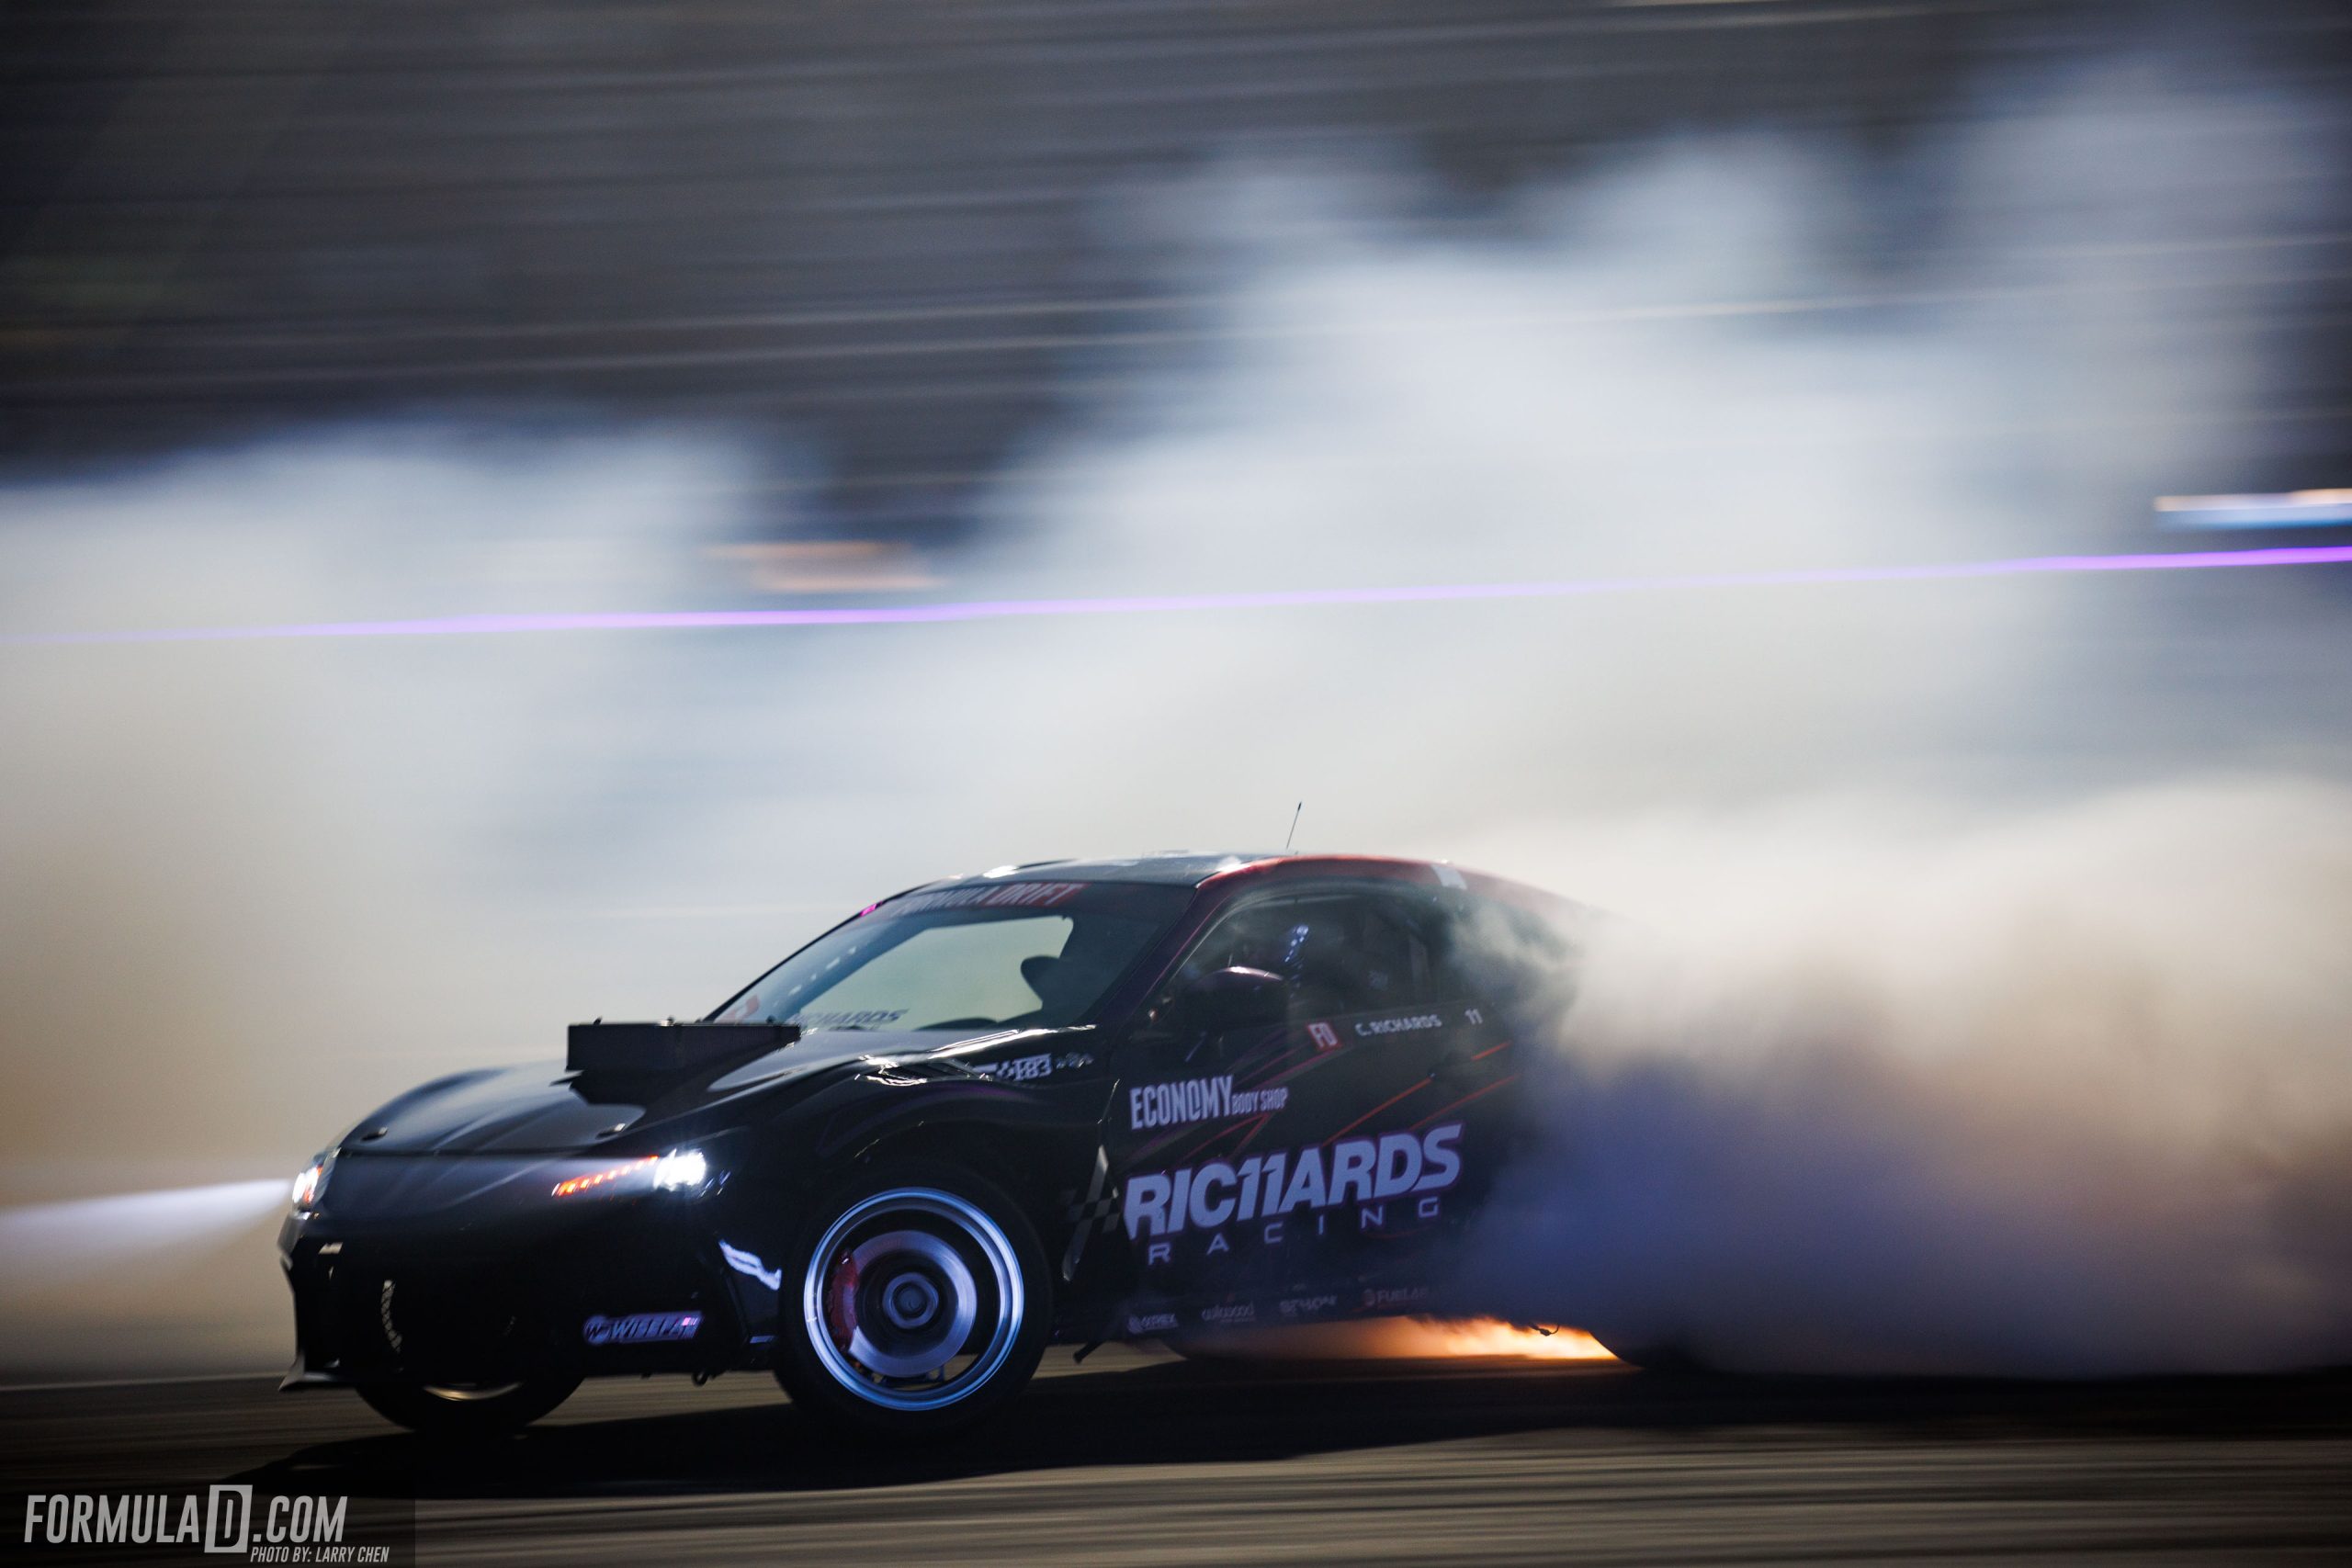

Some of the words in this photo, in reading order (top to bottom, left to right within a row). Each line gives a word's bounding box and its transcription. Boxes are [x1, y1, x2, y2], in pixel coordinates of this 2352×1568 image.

[1464, 1009, 1484, 1025] 11
[1129, 1075, 1234, 1130] ECONOMY
[1231, 1090, 1259, 1115] BODY
[1260, 1088, 1288, 1111] SHOP
[1148, 1197, 1440, 1266] RACING
